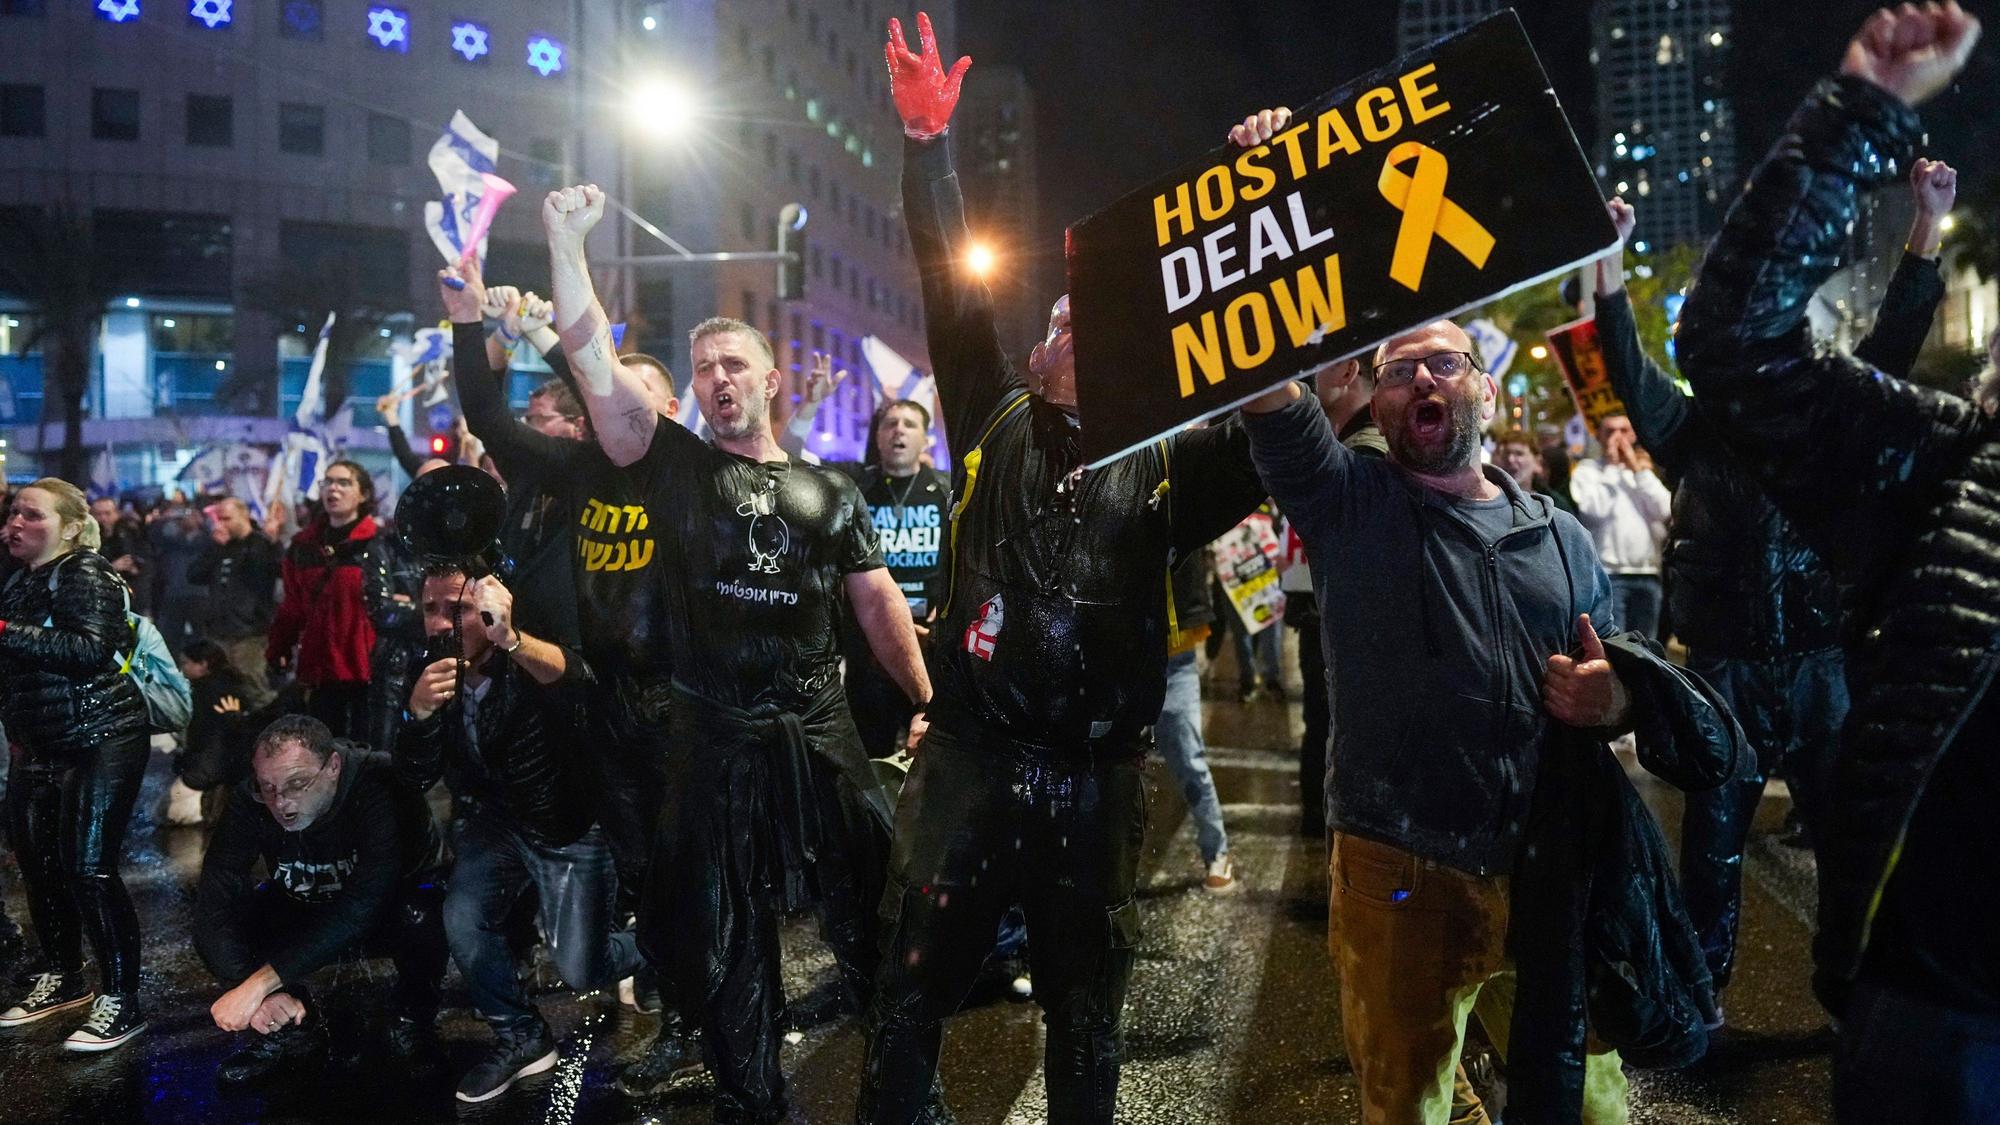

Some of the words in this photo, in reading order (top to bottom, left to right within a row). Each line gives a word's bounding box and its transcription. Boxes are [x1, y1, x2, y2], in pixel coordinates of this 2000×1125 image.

[1153, 63, 1451, 247] HOSTAGE
[1160, 191, 1334, 314] DEAL
[1171, 253, 1347, 398] NOW
[874, 526, 941, 553] RAELI
[884, 552, 939, 567] OCRACY
[769, 590, 798, 605] עדיין
